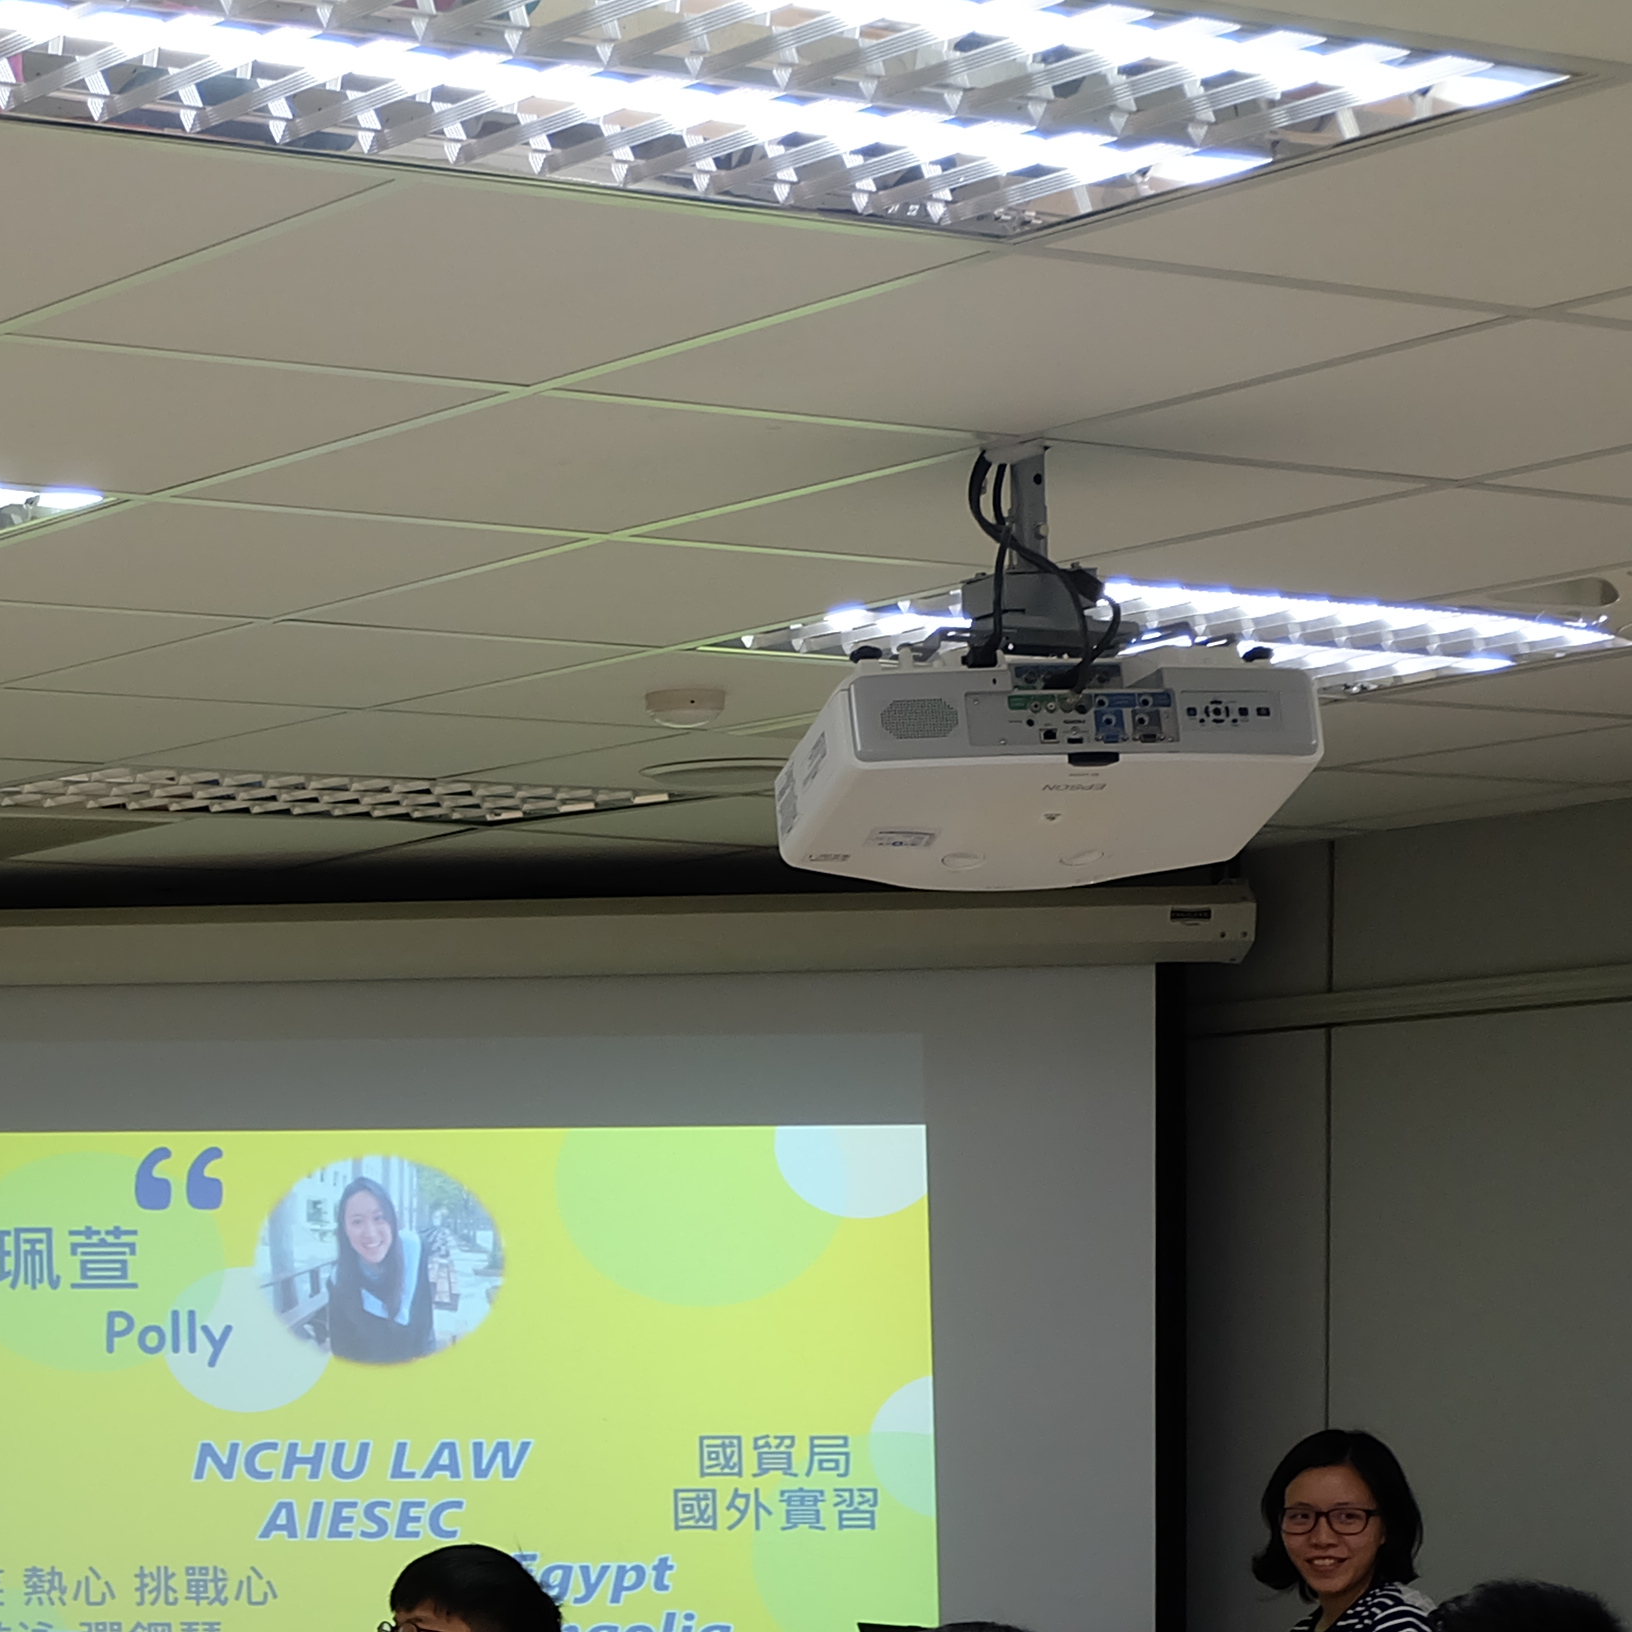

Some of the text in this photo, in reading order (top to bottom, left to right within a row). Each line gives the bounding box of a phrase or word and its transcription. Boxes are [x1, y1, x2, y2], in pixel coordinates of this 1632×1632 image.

[106, 1309, 233, 1368] Polly
[192, 1440, 533, 1481] NCHU LAW
[698, 1434, 851, 1478] 國貿局
[256, 1500, 466, 1540] AIESEC
[673, 1487, 879, 1531] 國外實習
[23, 1565, 116, 1608] 熱心
[134, 1565, 279, 1608] 挑戰心
